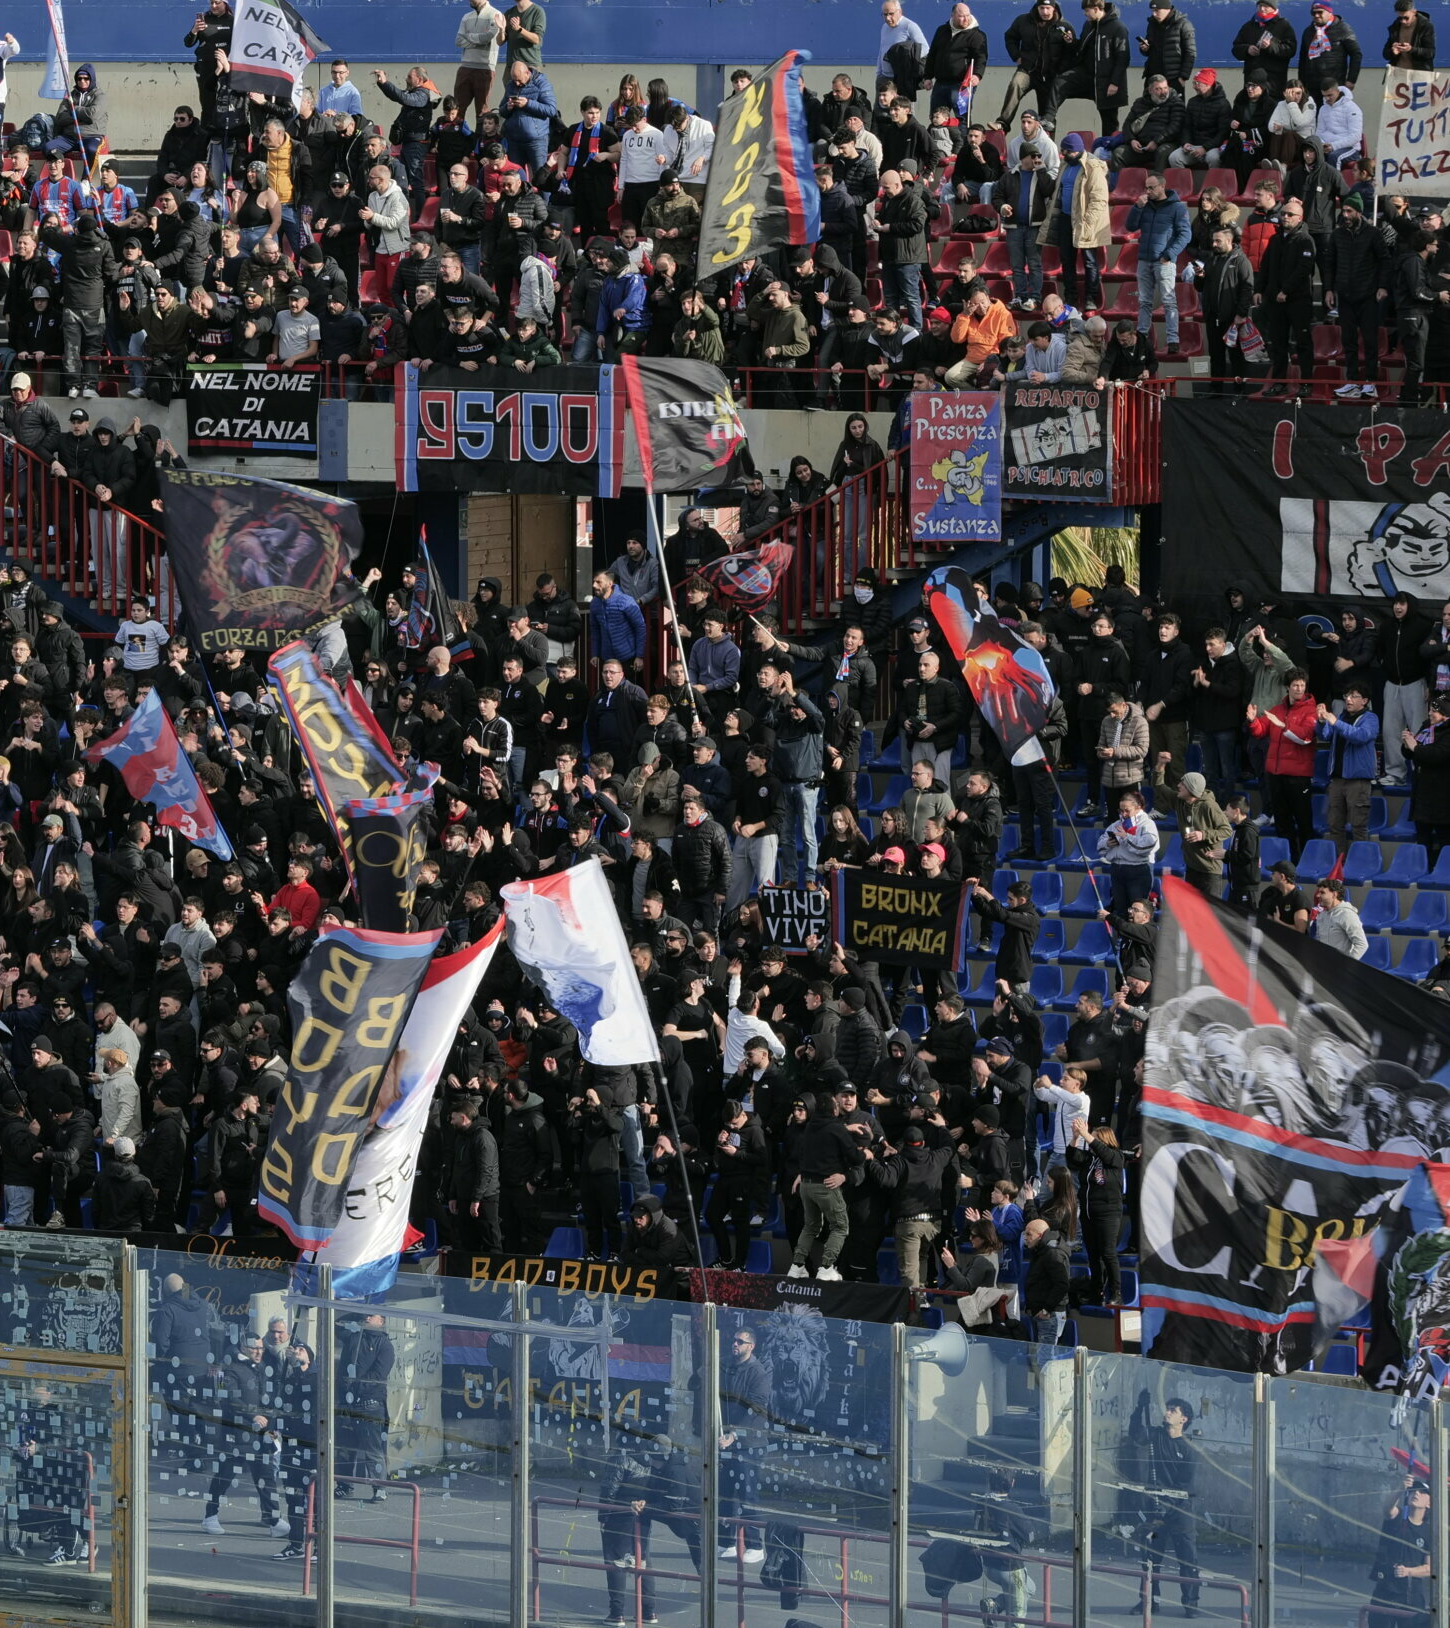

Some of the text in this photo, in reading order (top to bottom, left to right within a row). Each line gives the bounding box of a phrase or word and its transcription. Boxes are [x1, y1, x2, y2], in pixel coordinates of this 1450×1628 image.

[244, 7, 285, 32] NEL
[189, 372, 315, 393] NEL NOME
[243, 397, 267, 413] DI
[929, 397, 988, 420] Panza
[1015, 388, 1100, 408] REPARTO
[194, 417, 311, 441] CATANIA
[416, 389, 599, 464] 95100
[915, 418, 998, 441] Presenza
[1008, 465, 1104, 488] PSICHIATRICO
[914, 511, 1000, 535] Sustanza
[201, 628, 269, 650] FORZA
[764, 888, 826, 916] TINO
[862, 884, 943, 917] BRONX
[766, 917, 826, 943] VIVE
[853, 920, 947, 955] CATANIA
[469, 1256, 658, 1304] BAD BOYS
[776, 1280, 822, 1298] Catania
